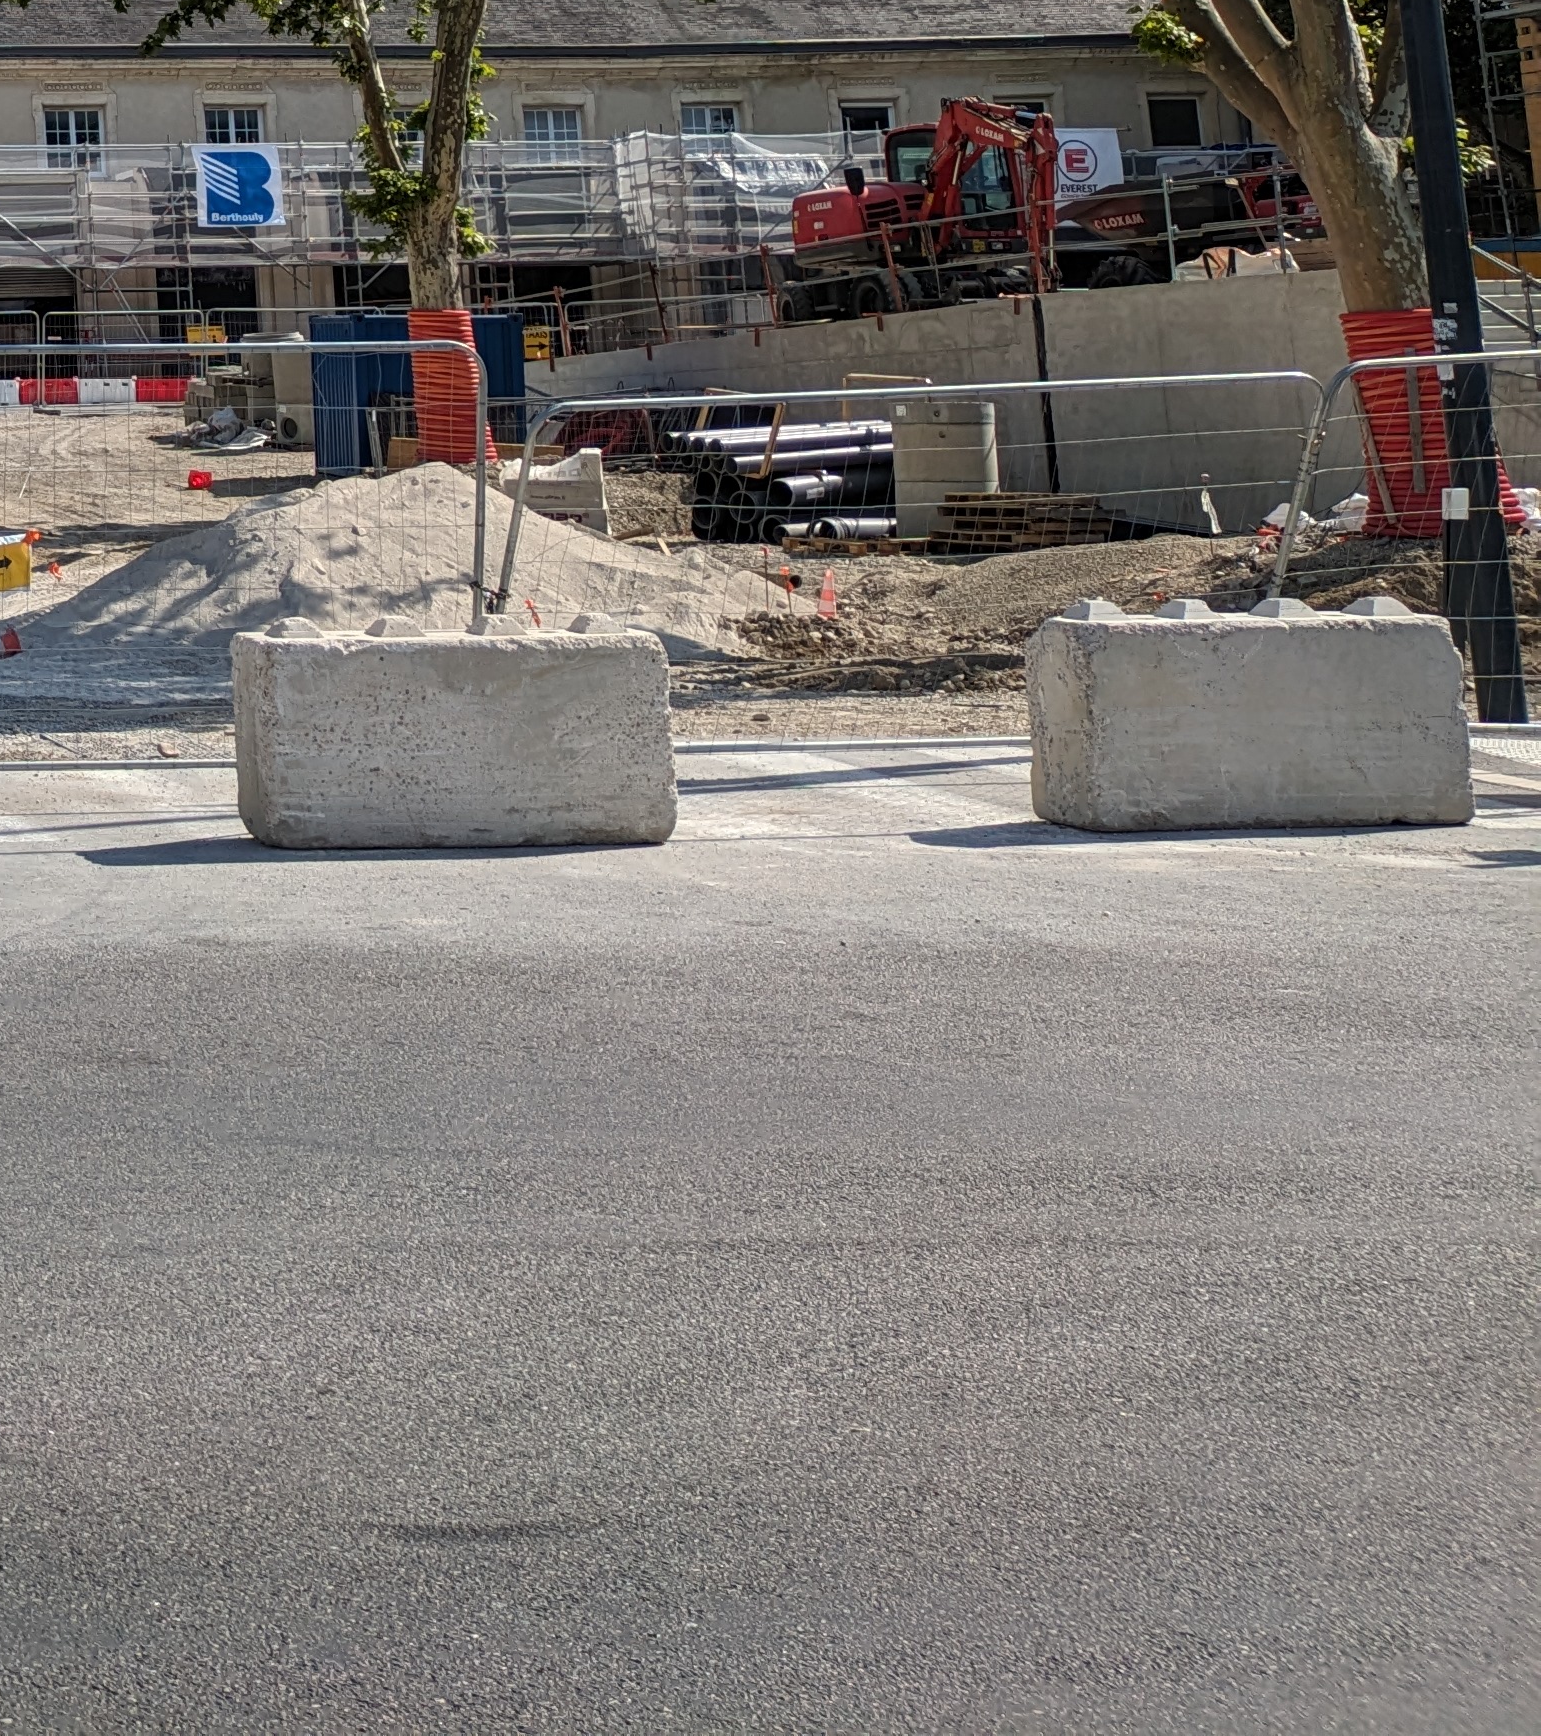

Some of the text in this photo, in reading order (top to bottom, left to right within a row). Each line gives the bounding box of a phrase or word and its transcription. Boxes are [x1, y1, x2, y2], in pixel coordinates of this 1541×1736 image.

[1060, 183, 1098, 193] EVEREST
[211, 212, 264, 223] Berthouly
[1102, 212, 1145, 229] LOXAM
